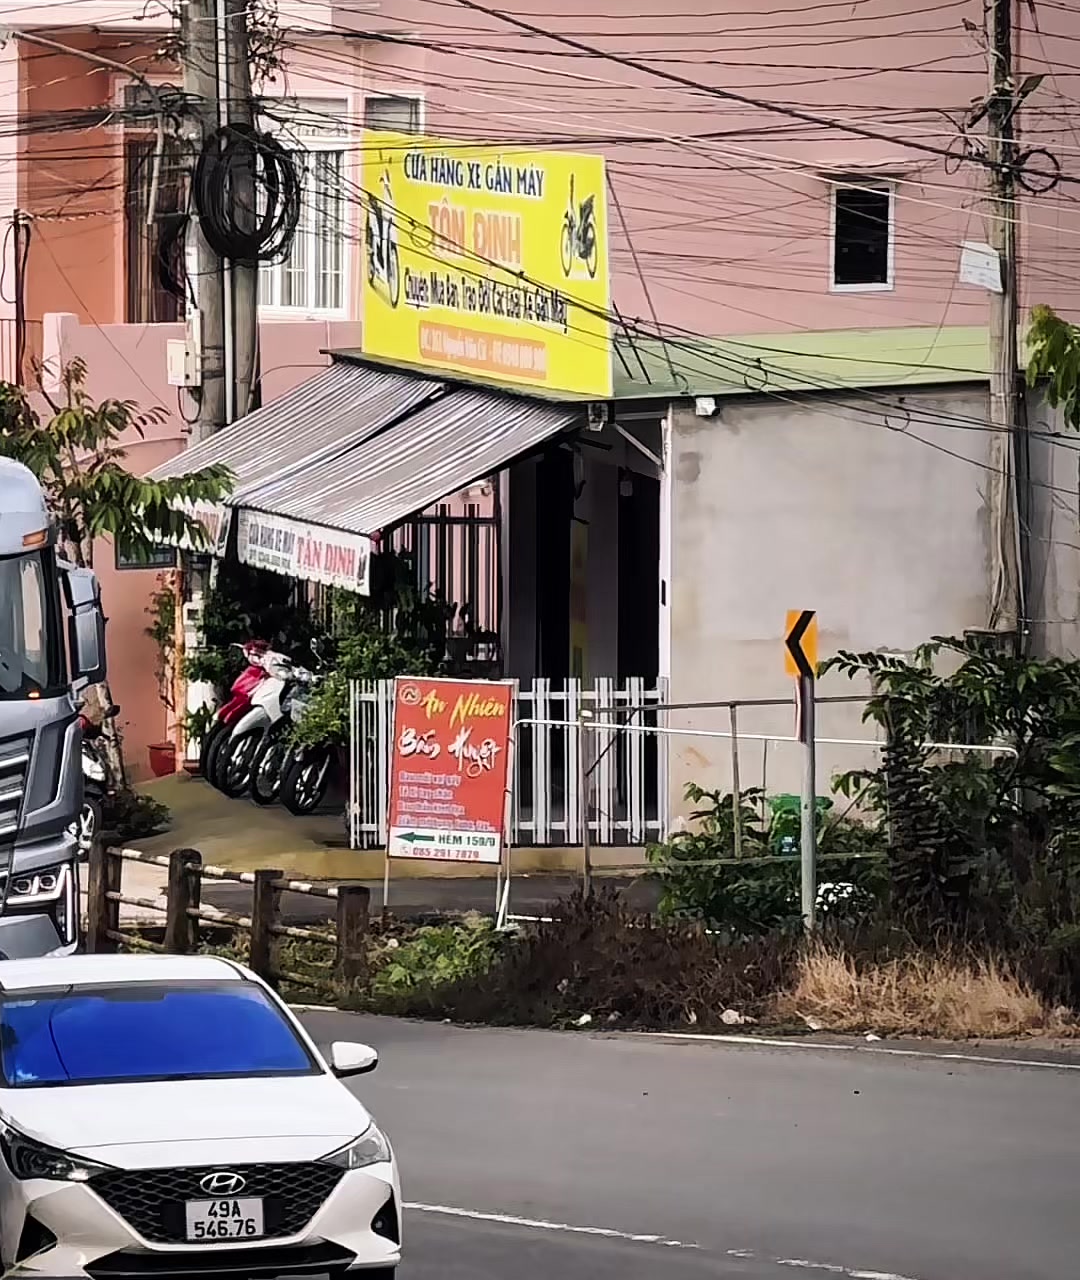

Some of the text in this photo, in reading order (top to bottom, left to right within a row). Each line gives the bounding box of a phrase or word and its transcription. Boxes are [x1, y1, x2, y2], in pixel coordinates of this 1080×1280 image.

[467, 162, 481, 189] XE
[517, 163, 544, 196] MÁY
[420, 689, 505, 728] An Nhiên
[208, 1201, 241, 1218] 49A
[194, 1218, 256, 1238] 546.76
